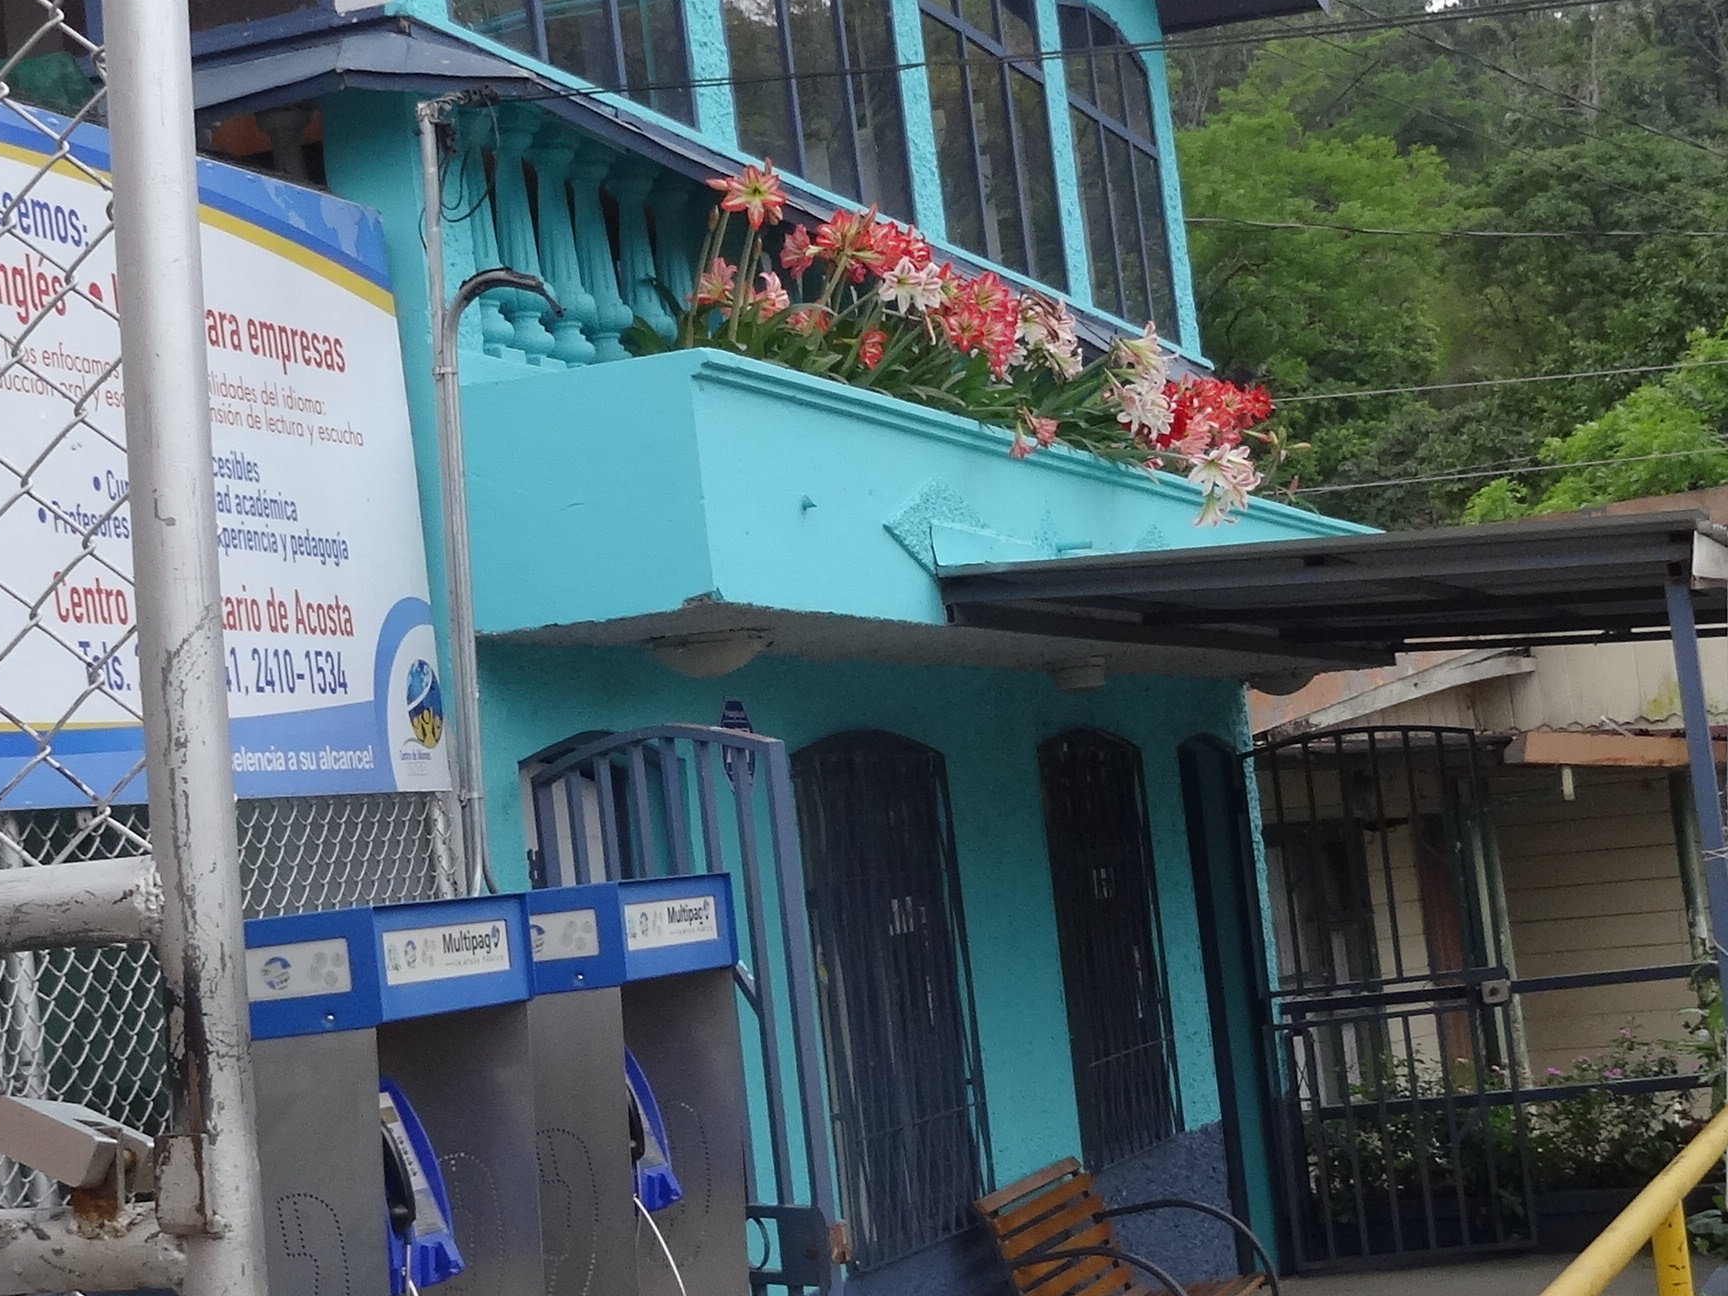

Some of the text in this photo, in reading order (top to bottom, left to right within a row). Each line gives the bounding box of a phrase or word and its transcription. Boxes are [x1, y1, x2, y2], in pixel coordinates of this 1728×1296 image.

[205, 307, 243, 353] ara
[247, 316, 346, 376] empresas
[41, 341, 121, 379] enfocamos
[208, 369, 258, 404] ilidades
[260, 379, 279, 408] del
[281, 384, 327, 417] idioma:
[209, 401, 244, 427] nsión
[245, 404, 262, 430] de
[263, 406, 305, 438] lectura
[306, 424, 315, 446] y
[317, 420, 364, 447] escucha
[212, 449, 261, 483] cesibles
[216, 484, 299, 522] ad académica
[51, 500, 130, 540] Profesores
[279, 532, 288, 562] y
[289, 528, 350, 568] pedagogía
[52, 570, 129, 626] Centro
[266, 586, 290, 634] de
[294, 588, 355, 638] Acosta
[250, 646, 349, 696] 2410-1534
[232, 744, 283, 773] elencia
[287, 749, 298, 772] a
[300, 748, 318, 771] su
[319, 744, 375, 772] alcance!
